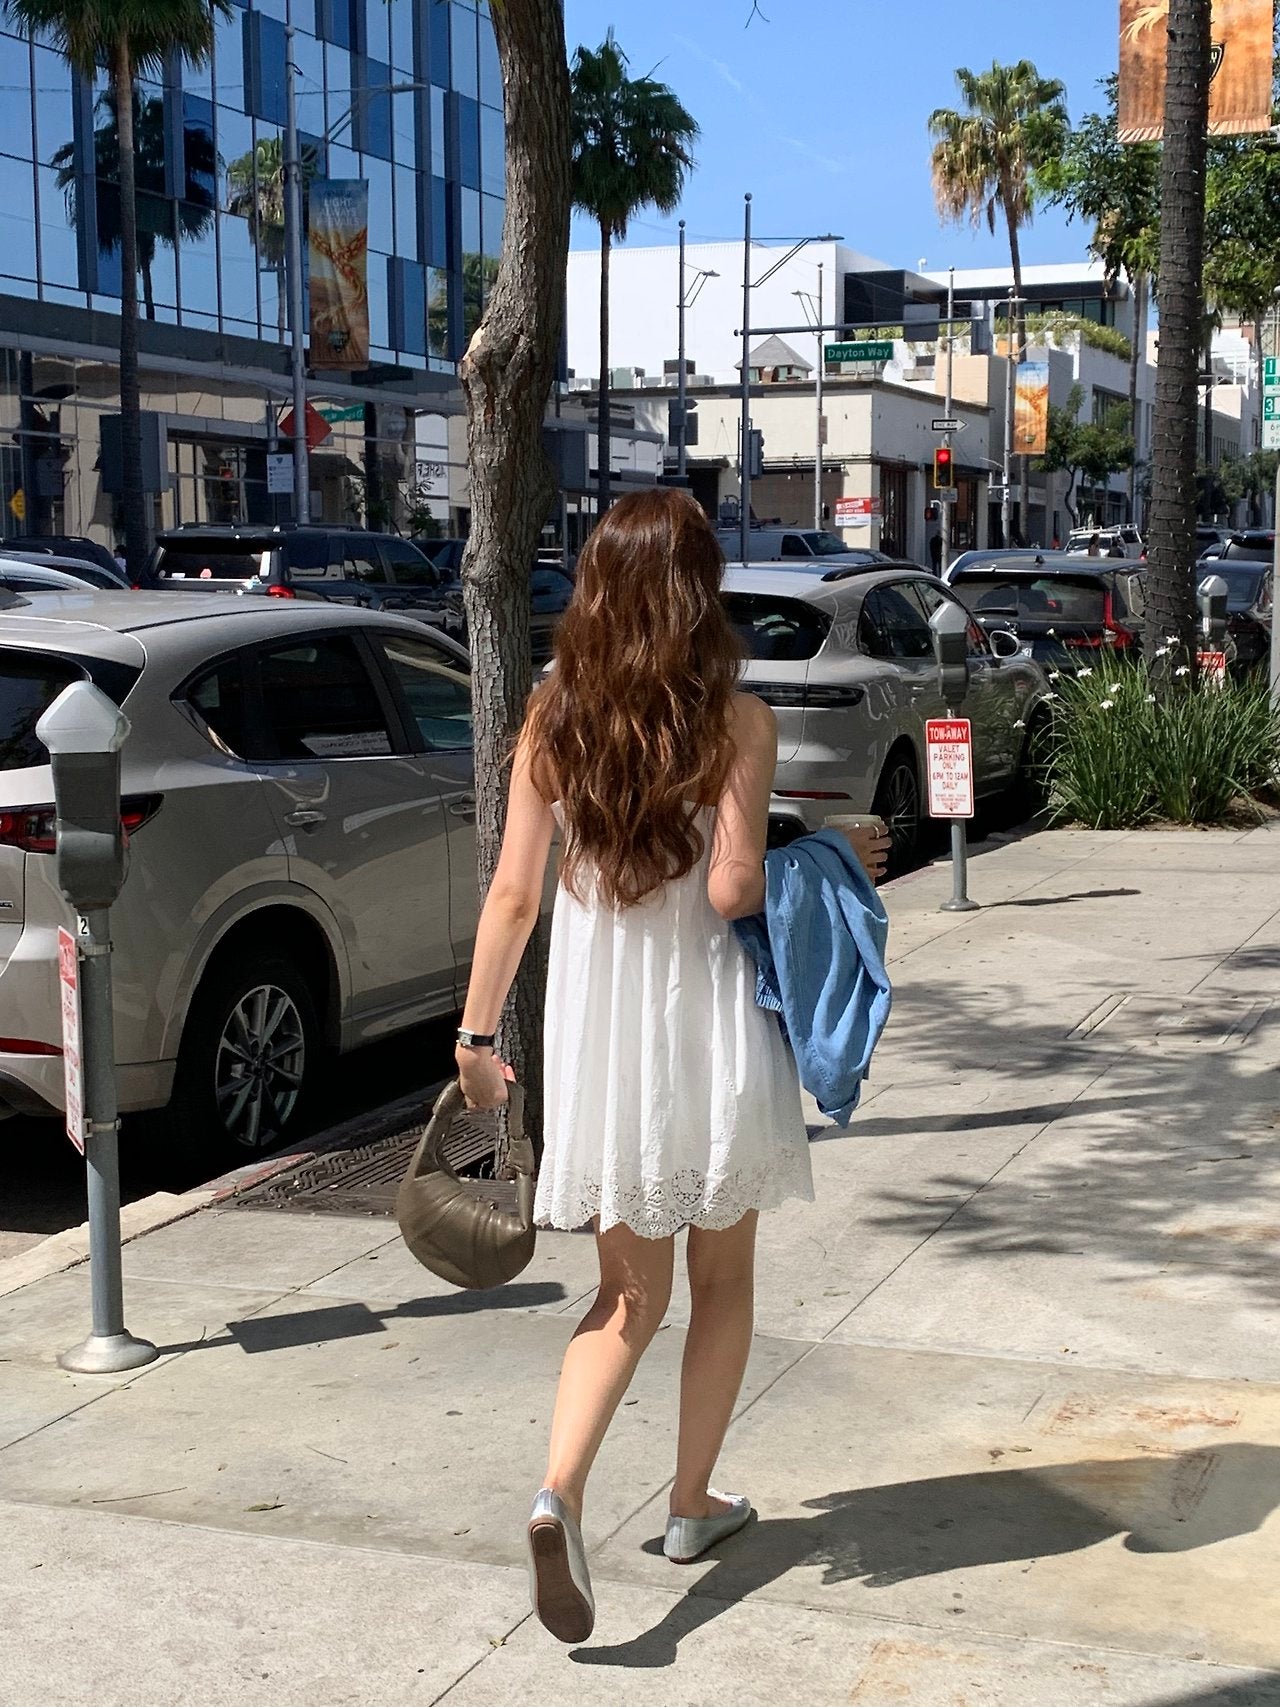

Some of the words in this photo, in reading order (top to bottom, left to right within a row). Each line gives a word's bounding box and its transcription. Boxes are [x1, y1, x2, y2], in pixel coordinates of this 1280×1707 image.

[324, 196, 352, 207] LIGHT
[828, 349, 865, 360] Dayton
[868, 347, 889, 358] Way
[929, 727, 968, 741] TOW-AWAY
[938, 744, 960, 753] VALET
[933, 753, 965, 762] PARKING
[942, 762, 957, 770] ONLY
[946, 772, 954, 781] TO
[942, 782, 958, 790] DAILY
[81, 917, 88, 935] 2
